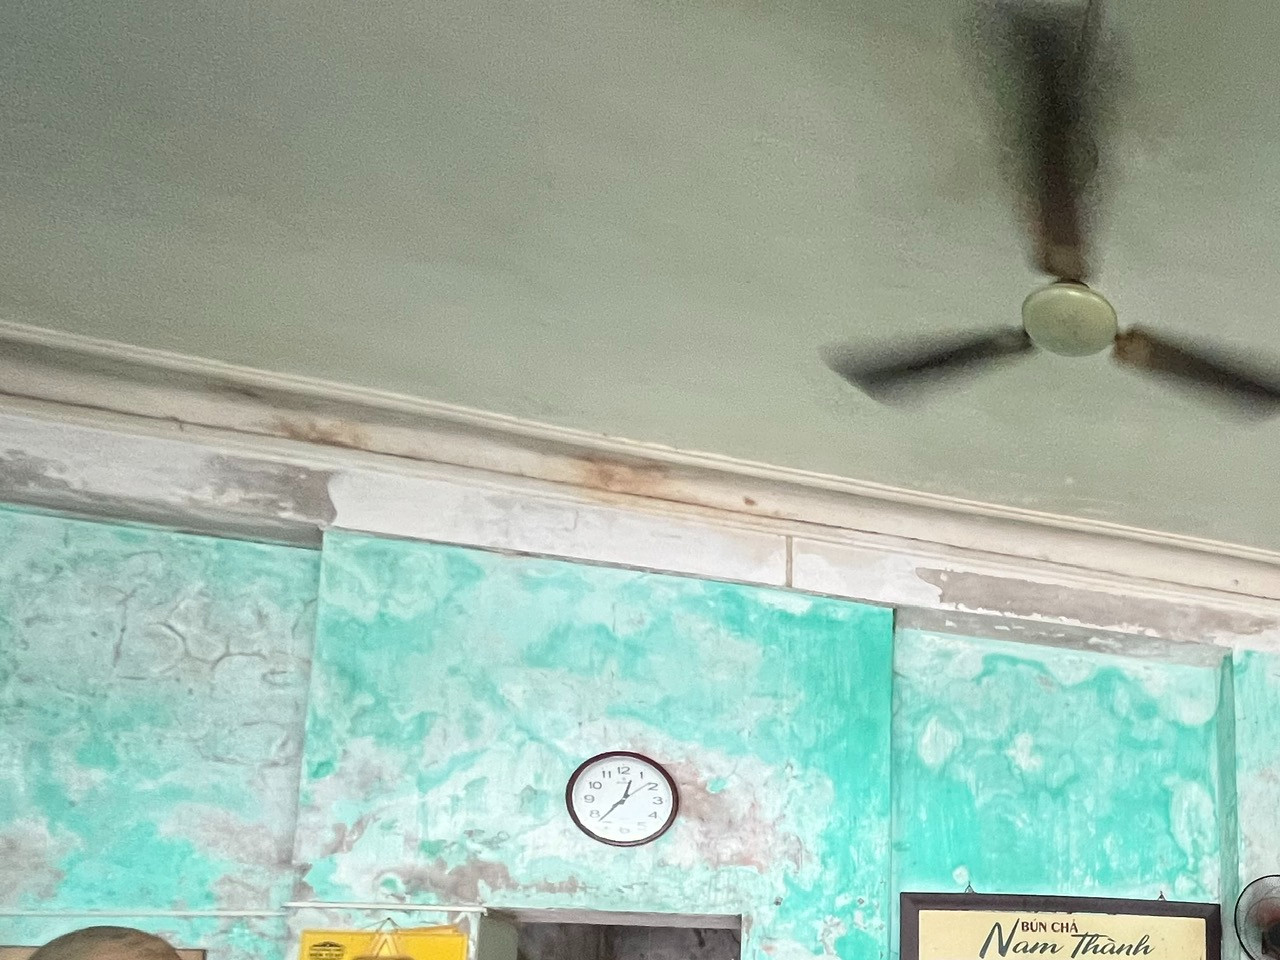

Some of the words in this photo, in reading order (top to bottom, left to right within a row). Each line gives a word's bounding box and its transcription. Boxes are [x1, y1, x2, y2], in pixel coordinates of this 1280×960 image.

[602, 770, 611, 778] 11
[617, 766, 630, 775] 12
[589, 781, 602, 790] 10
[584, 794, 595, 803] 9
[652, 796, 663, 805] 3
[589, 809, 600, 819] 8
[648, 811, 657, 819] 4
[1021, 918, 1047, 933] BÚN
[1050, 918, 1079, 934] CHẢ
[979, 917, 1065, 959] Nam
[1070, 931, 1155, 959] Thành
